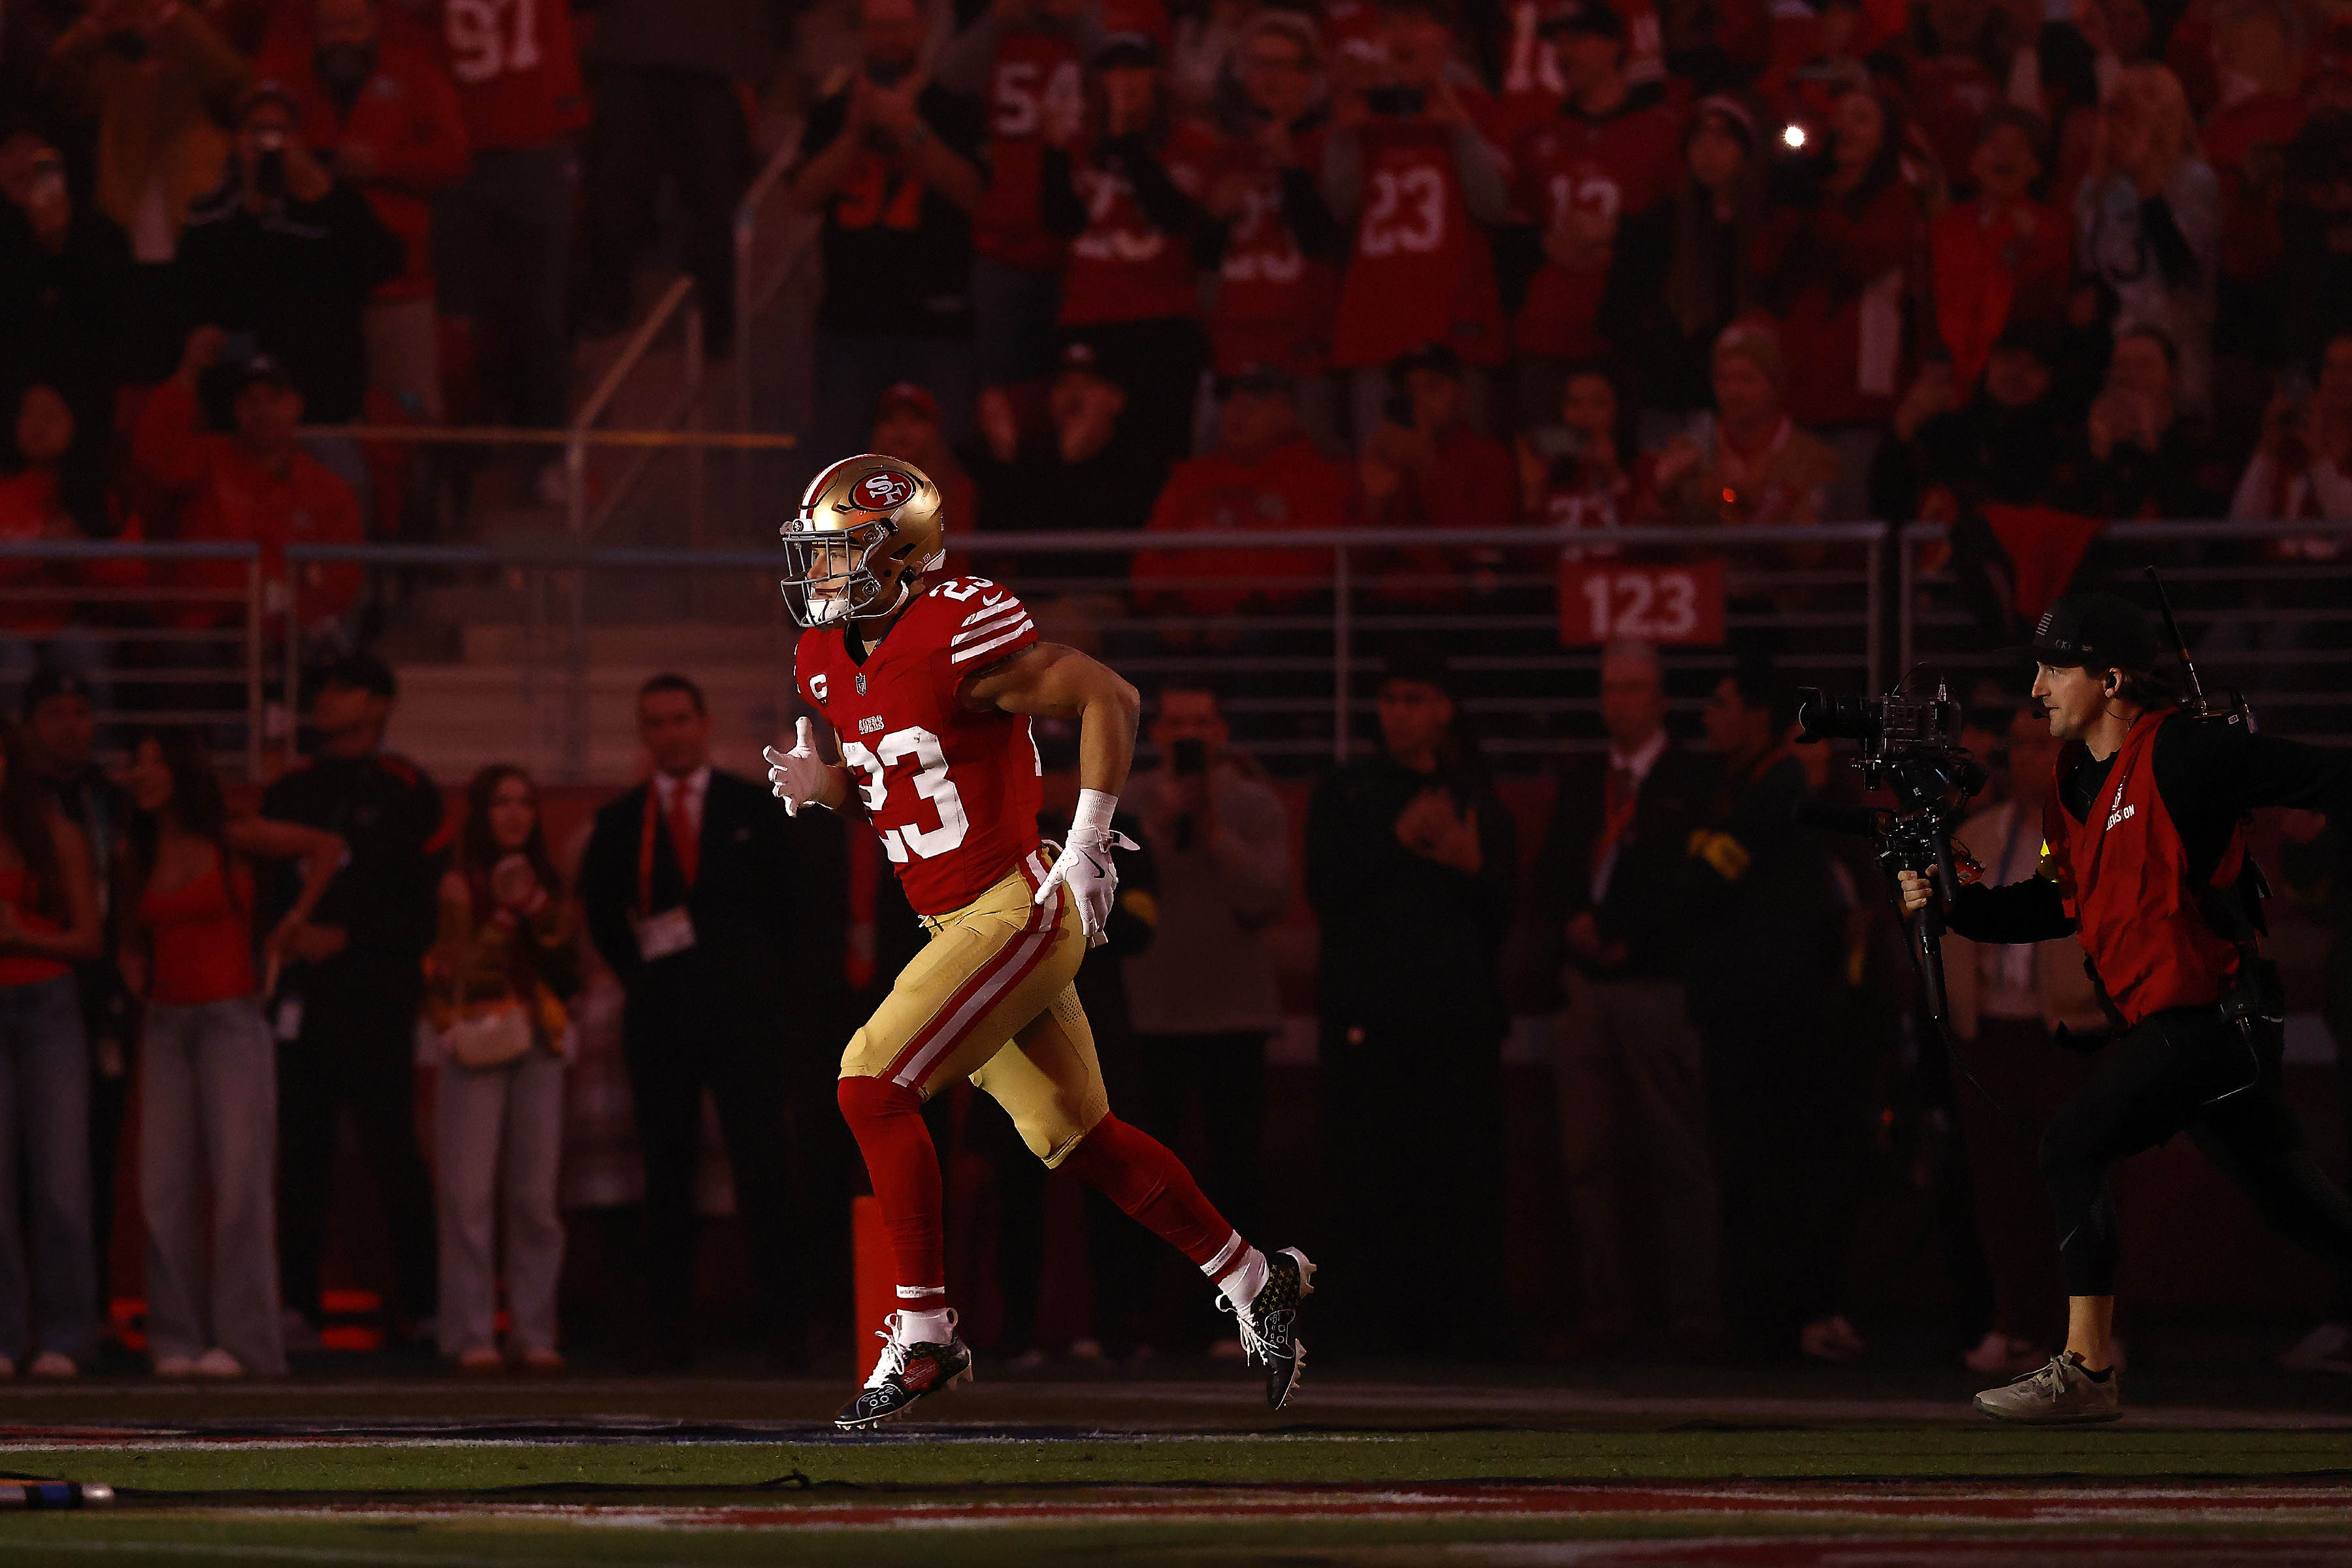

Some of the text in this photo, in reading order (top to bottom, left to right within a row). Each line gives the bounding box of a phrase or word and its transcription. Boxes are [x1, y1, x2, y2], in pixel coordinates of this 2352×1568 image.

[446, 0, 542, 82] 91
[995, 59, 1083, 136] 54
[1360, 167, 1445, 258] 23
[866, 474, 907, 506] SF
[1582, 572, 1697, 639] 123
[809, 674, 828, 700] C
[842, 725, 970, 863] 23
